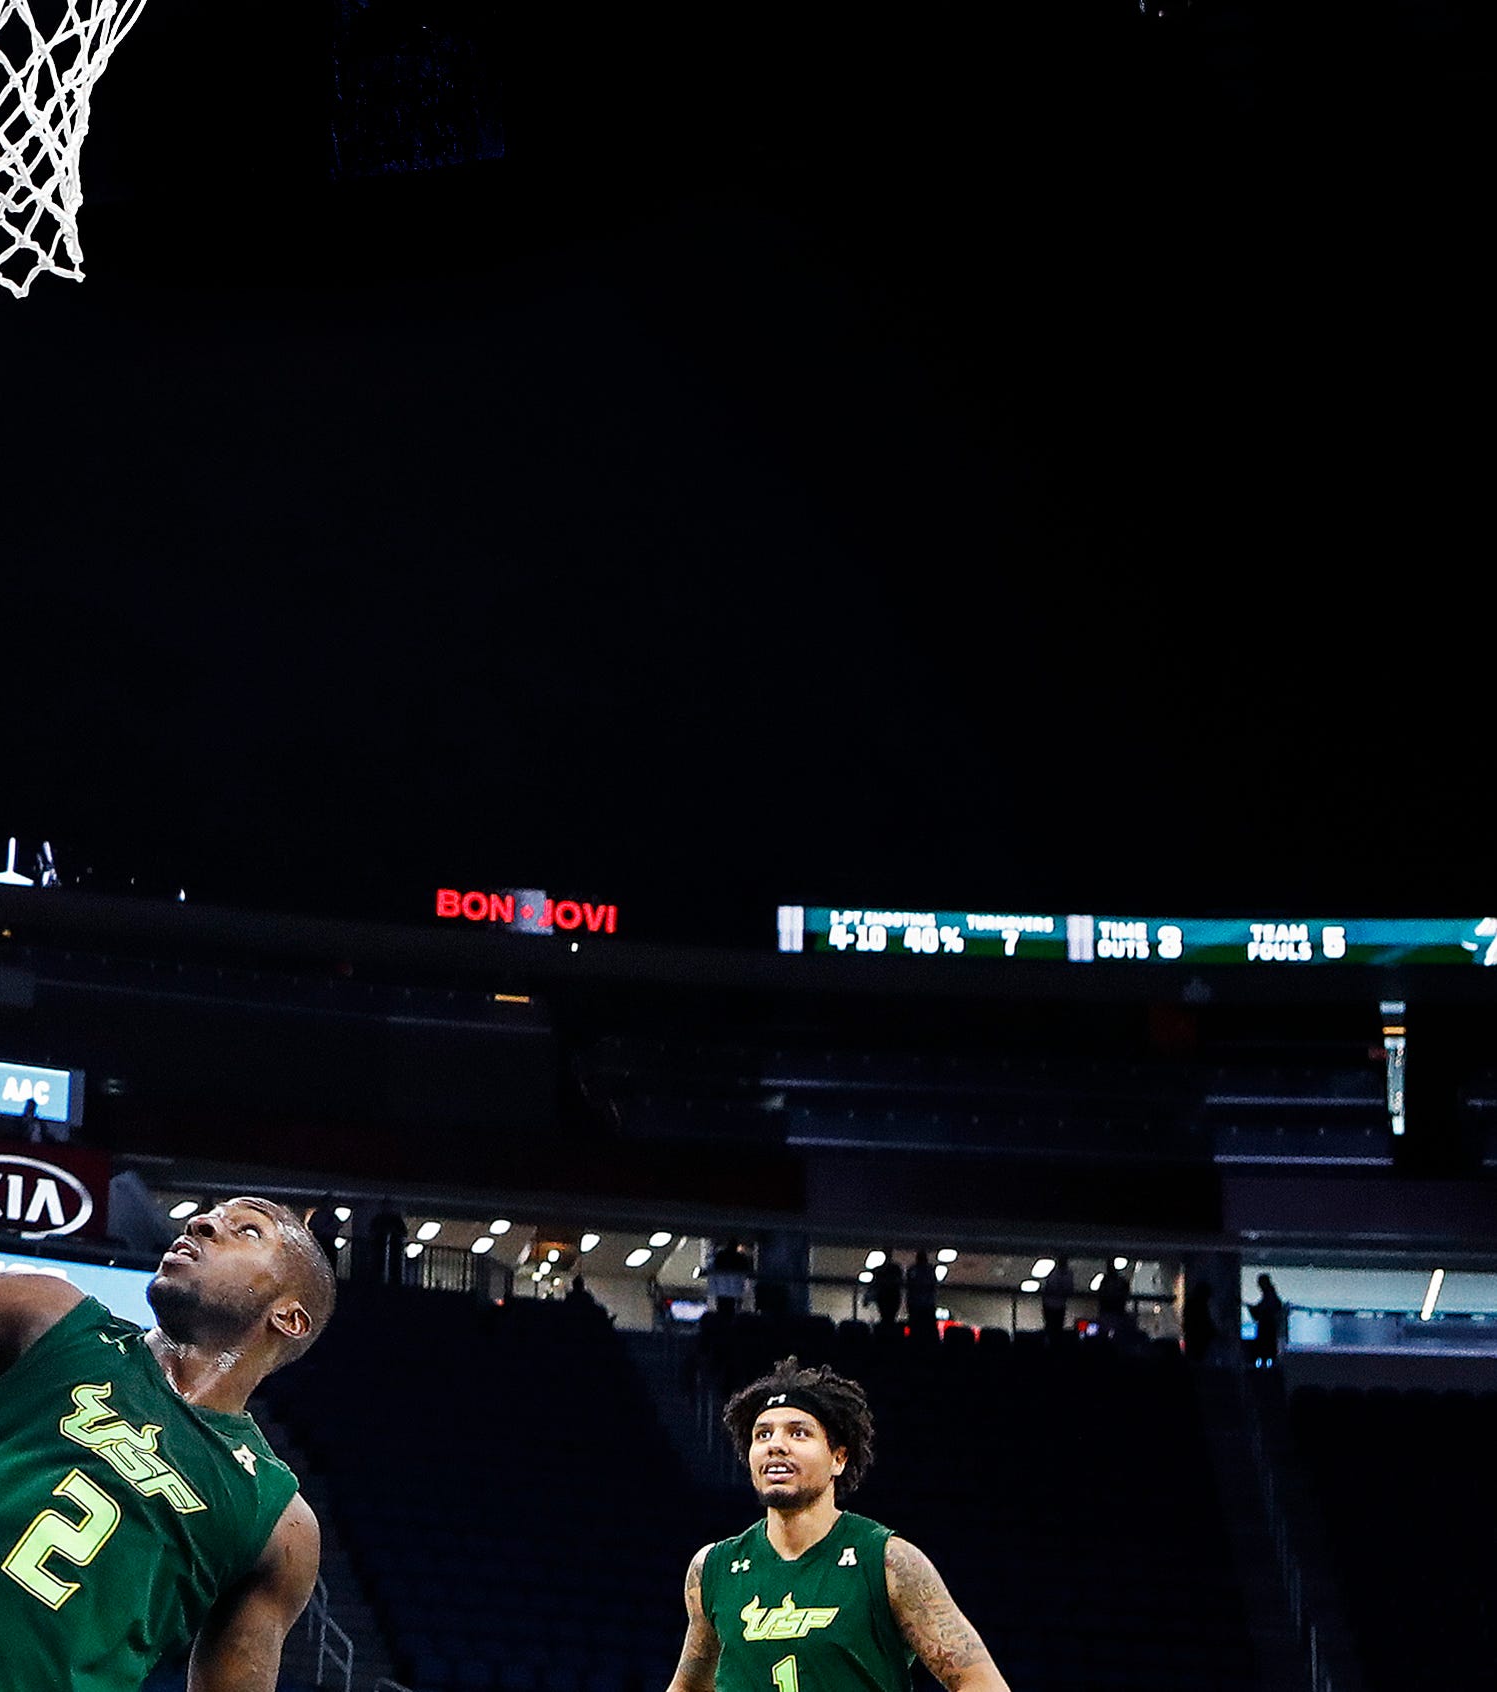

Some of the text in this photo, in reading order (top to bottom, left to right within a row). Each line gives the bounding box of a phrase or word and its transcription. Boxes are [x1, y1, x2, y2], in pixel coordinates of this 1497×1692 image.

[436, 888, 618, 934] BON JOVI
[829, 924, 887, 952] 4-10
[1002, 930, 1020, 956] 7
[1098, 921, 1147, 939] TIME
[1249, 923, 1308, 942] TEAM
[1098, 939, 1150, 959] OUTS
[1248, 941, 1312, 960] FOULS
[2, 1076, 50, 1105] AAC
[59, 1381, 209, 1514] USF
[1, 1467, 122, 1611] 2
[837, 1547, 858, 1567] A
[740, 1592, 840, 1642] USF
[772, 1654, 799, 1692] 1
